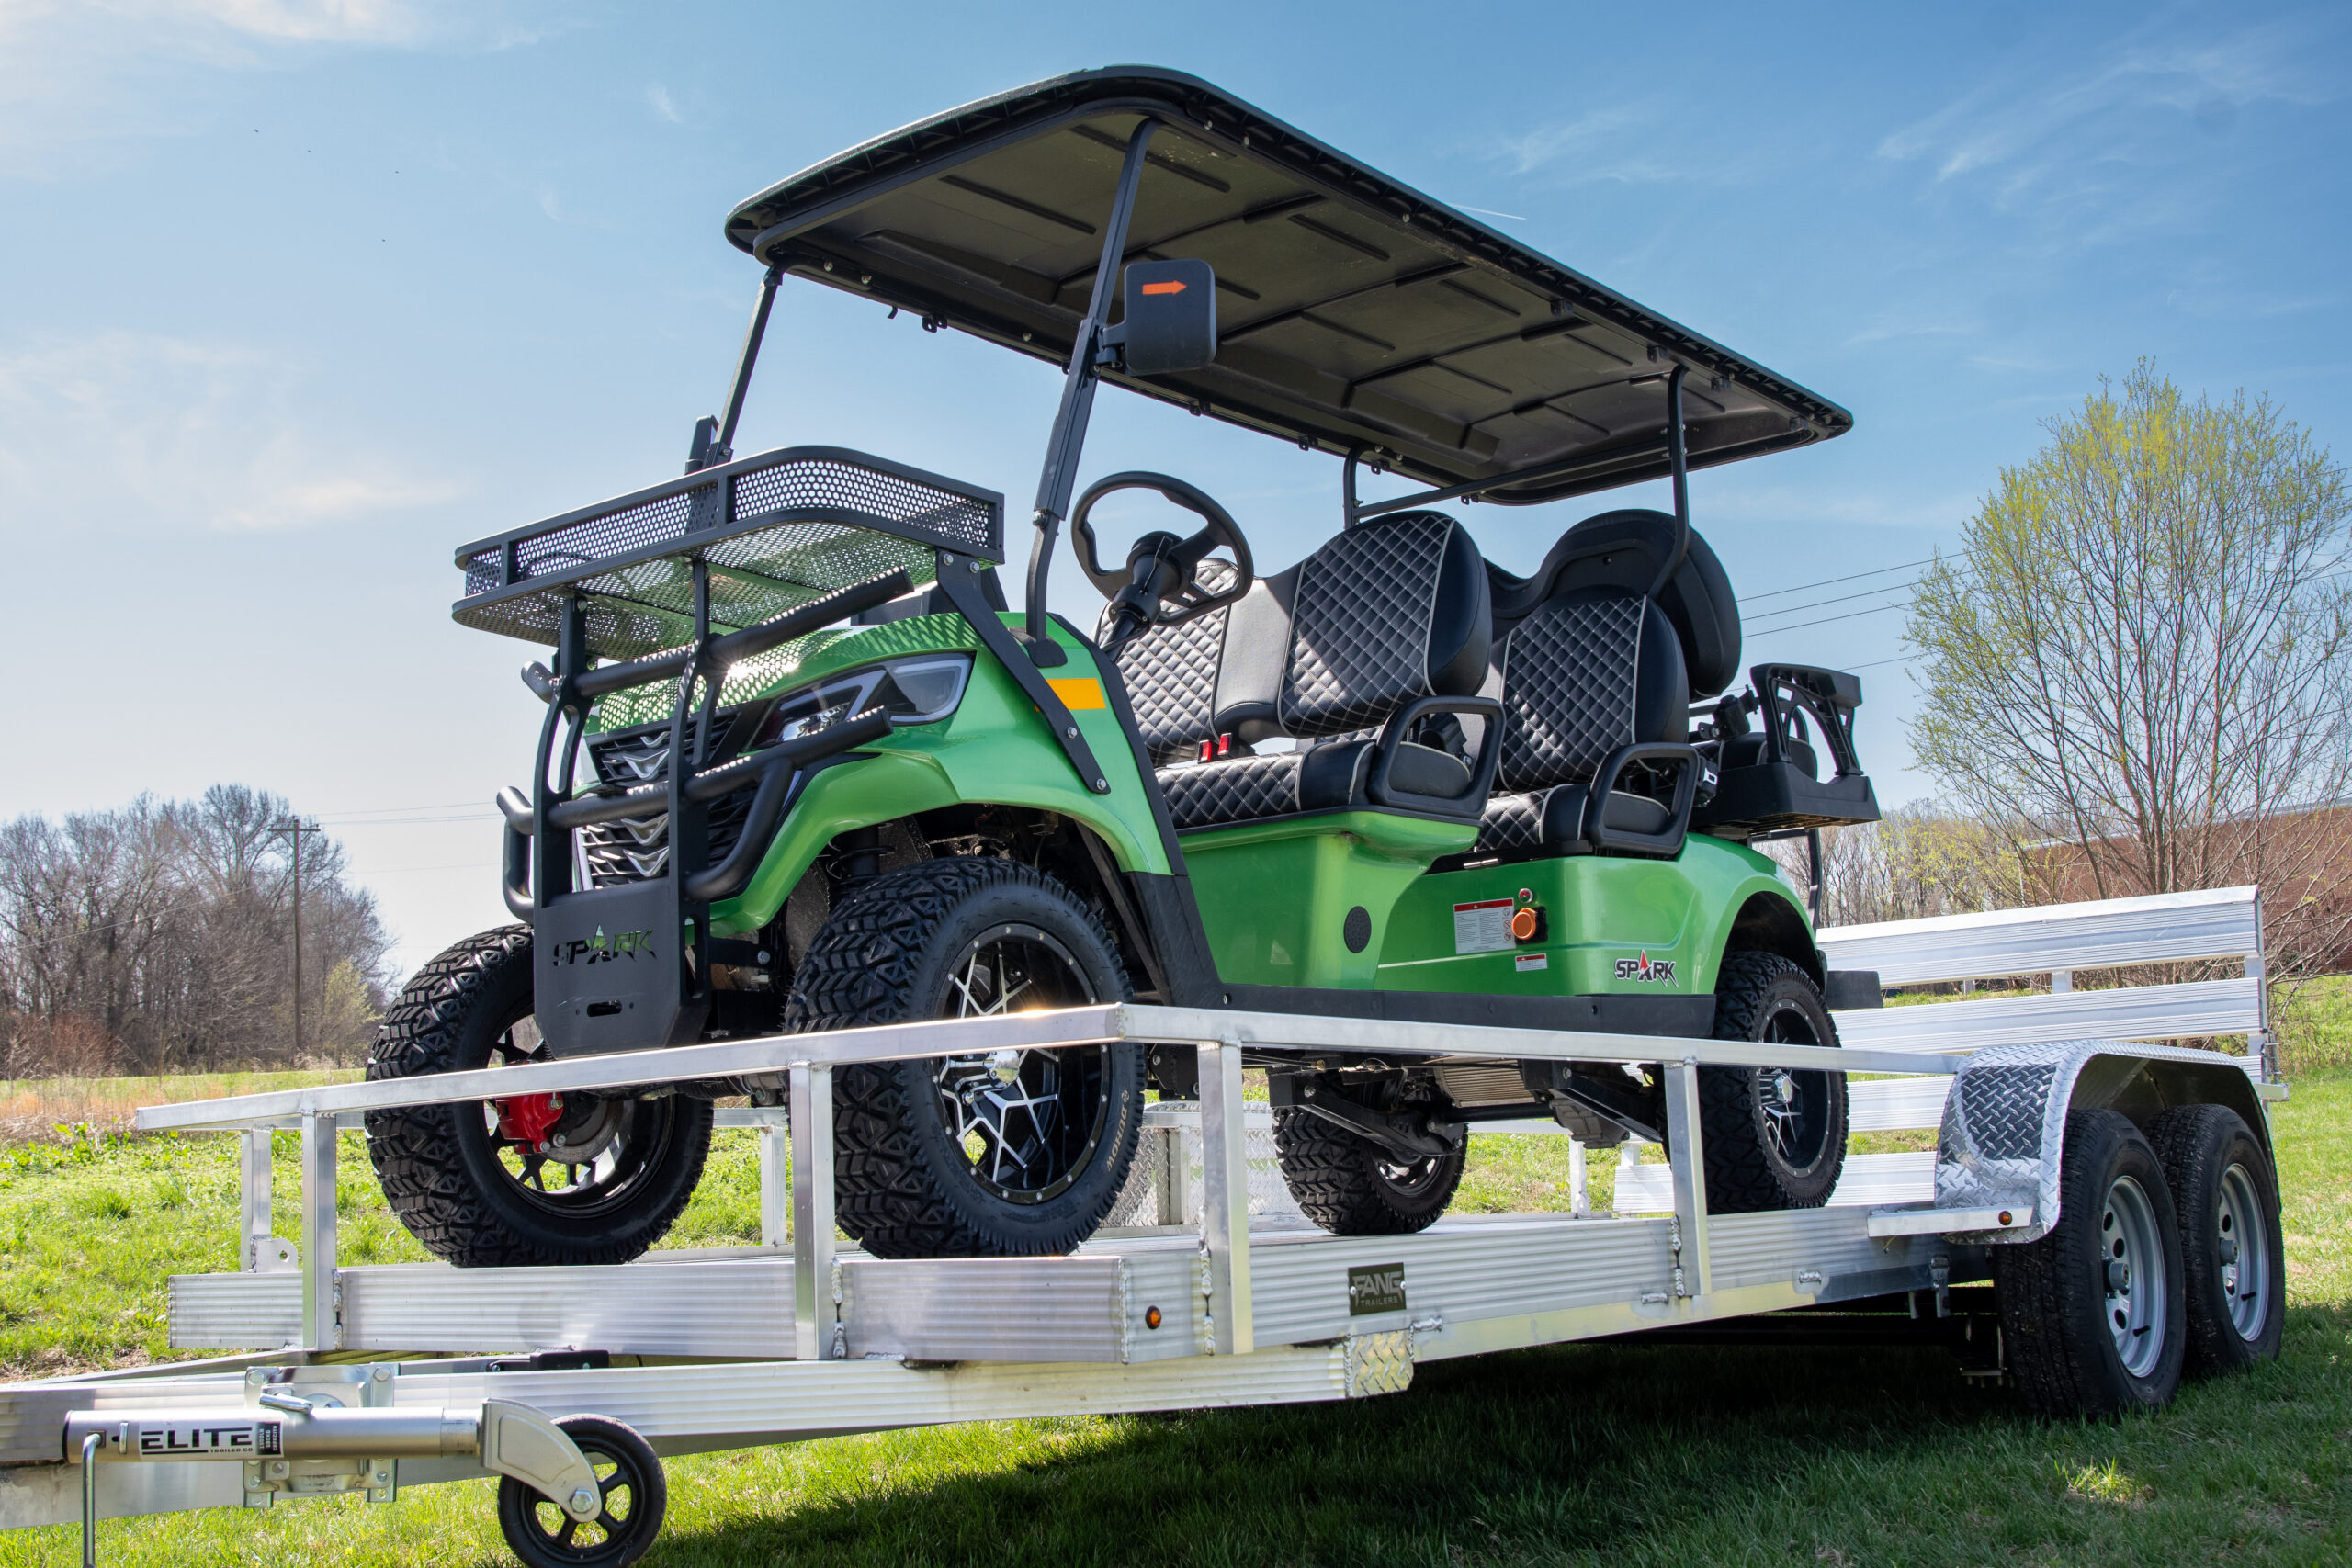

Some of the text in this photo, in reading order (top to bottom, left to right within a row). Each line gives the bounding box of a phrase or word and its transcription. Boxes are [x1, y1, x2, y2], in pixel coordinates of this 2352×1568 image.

[553, 922, 657, 966] SPARK
[1614, 948, 1679, 987] SPARK
[1352, 1271, 1403, 1307] FANG
[1361, 1296, 1397, 1306] TRAILERS
[141, 1427, 253, 1450] ELITE
